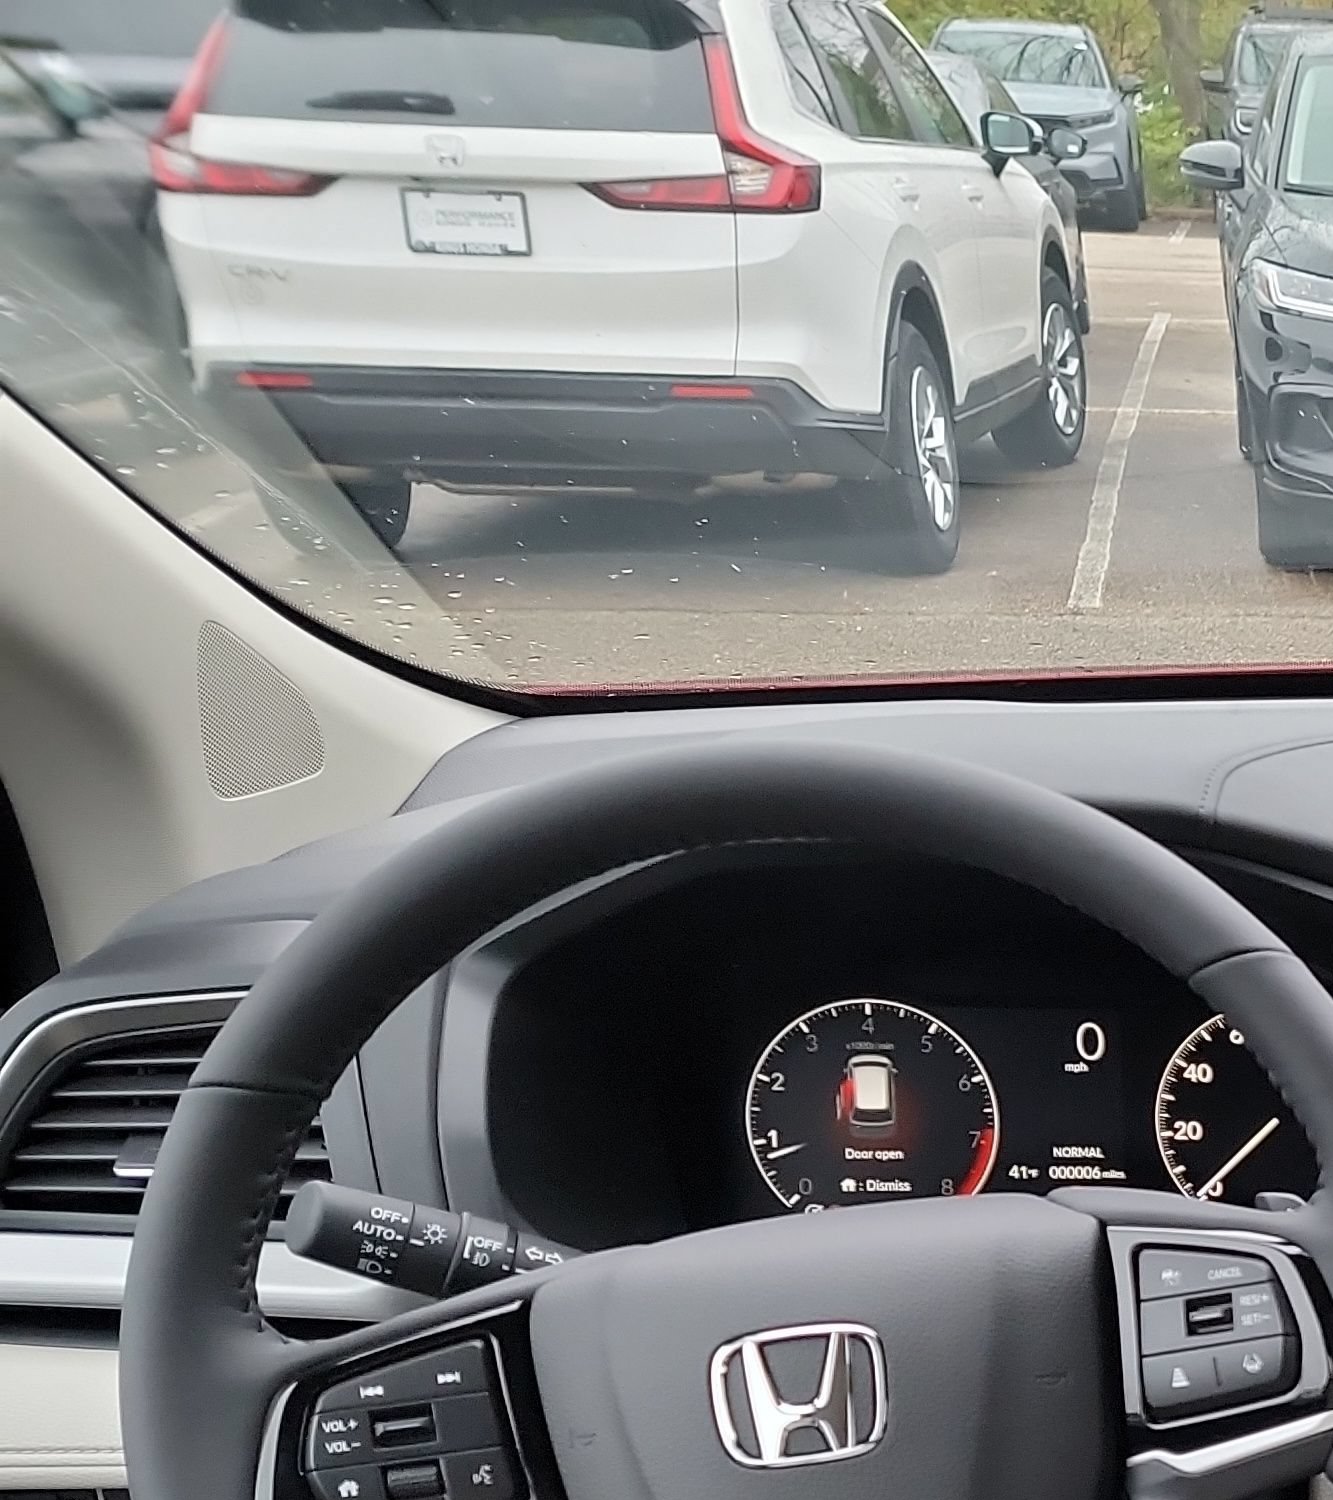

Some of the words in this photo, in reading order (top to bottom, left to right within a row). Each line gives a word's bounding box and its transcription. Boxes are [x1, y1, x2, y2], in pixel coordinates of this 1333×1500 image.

[862, 1016, 875, 1035] 4
[806, 1034, 818, 1052] 3
[921, 1035, 933, 1052] 5
[1076, 1021, 1105, 1061] 0
[1065, 1061, 1088, 1075] mph
[1183, 1063, 1213, 1083] 40
[770, 1073, 785, 1091] 2
[959, 1074, 971, 1091] 6
[1173, 1120, 1203, 1141] 20
[845, 1148, 871, 1160] Door
[874, 1149, 904, 1162] open
[1052, 1146, 1105, 1158] NORMAL
[1049, 1165, 1101, 1180] 000006
[799, 1178, 812, 1196] 0
[866, 1179, 912, 1192] Dismiss
[941, 1178, 953, 1196] 8
[370, 1207, 401, 1223] OFF
[353, 1220, 396, 1241] AUTO
[474, 1237, 502, 1251] OFF
